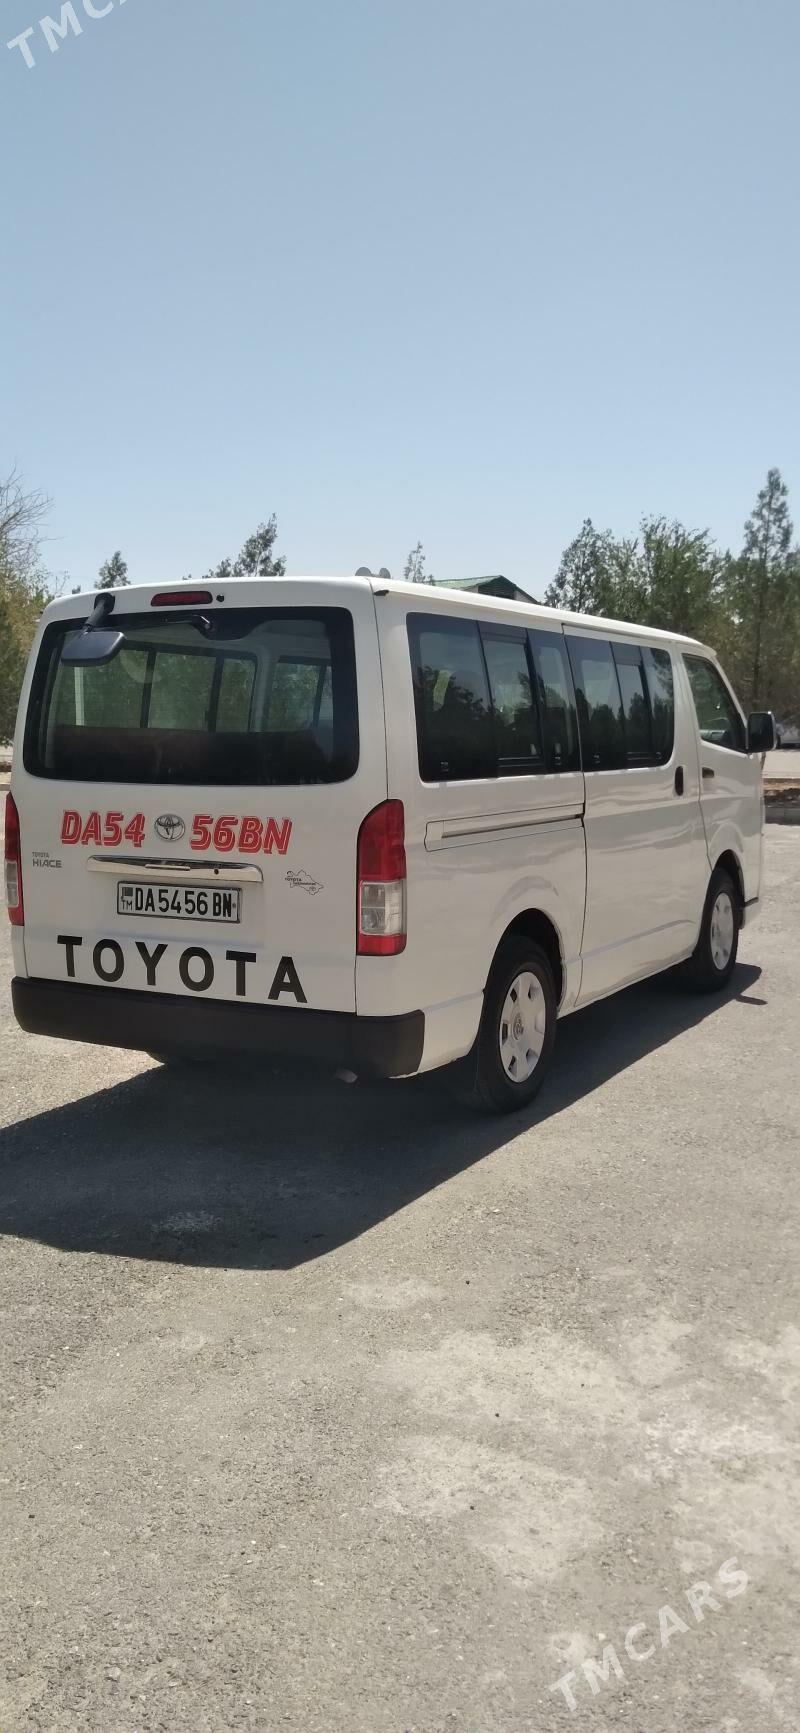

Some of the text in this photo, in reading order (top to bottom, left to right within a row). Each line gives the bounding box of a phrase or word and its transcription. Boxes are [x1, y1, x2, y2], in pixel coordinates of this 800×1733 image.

[60, 809, 293, 855] DA54 56BN
[32, 858, 62, 868] HIACE
[57, 935, 308, 1004] TOYOTA
